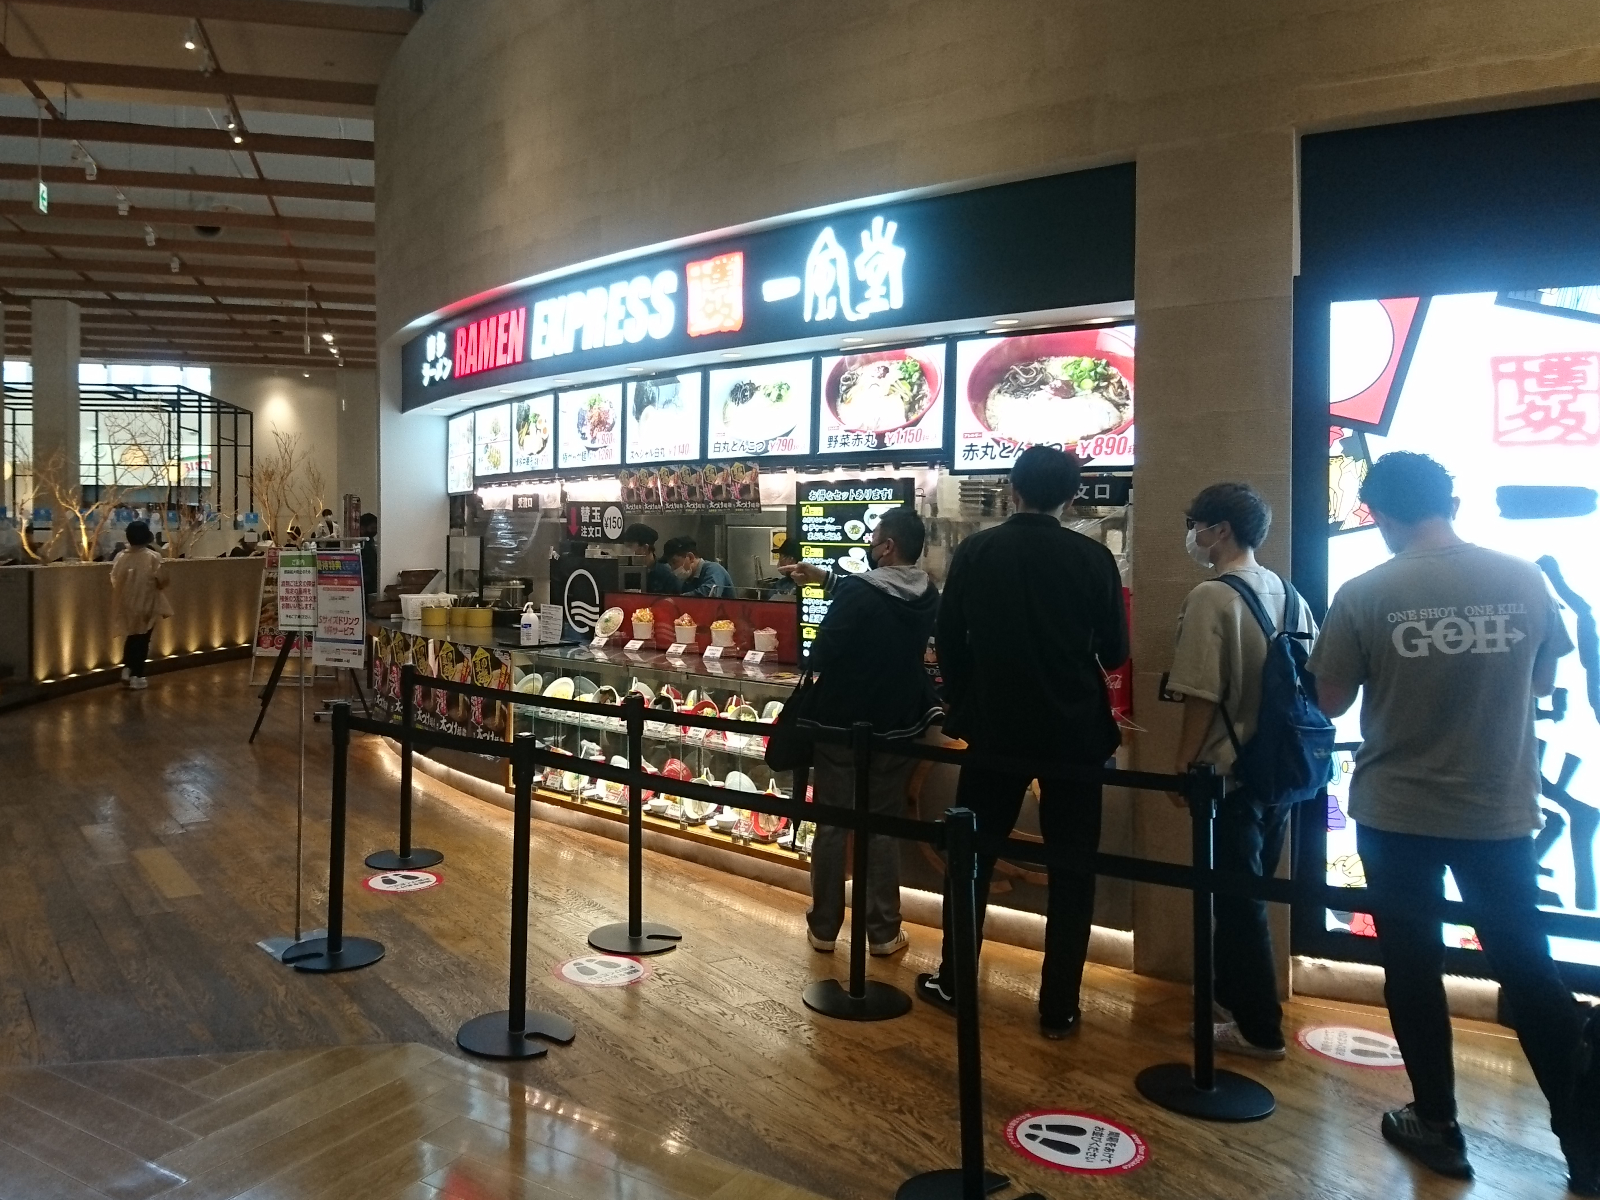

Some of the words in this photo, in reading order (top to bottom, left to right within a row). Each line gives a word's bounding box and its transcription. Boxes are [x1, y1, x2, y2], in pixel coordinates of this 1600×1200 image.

[762, 216, 906, 321] 一風堂
[454, 307, 526, 379] RAMEN
[530, 270, 678, 360] EXPRESS
[713, 440, 765, 453] 白丸とんこつ
[770, 438, 794, 452] ¥790
[827, 433, 876, 449] 野菜赤丸
[1080, 436, 1129, 456] ¥890
[517, 497, 533, 508] 受渡口
[580, 505, 602, 524] 替玉
[603, 516, 623, 530] ¥150
[580, 525, 602, 538] 注文口
[318, 615, 360, 626] Sサイズドリンク
[1387, 610, 1417, 623] ONE
[1420, 606, 1457, 619] SHOT
[1464, 605, 1494, 617] ONE
[1498, 603, 1527, 615] KILL
[1086, 1125, 1105, 1163] お並びください
[1137, 1145, 1146, 1155] Your
[1121, 1155, 1145, 1170] Distance
